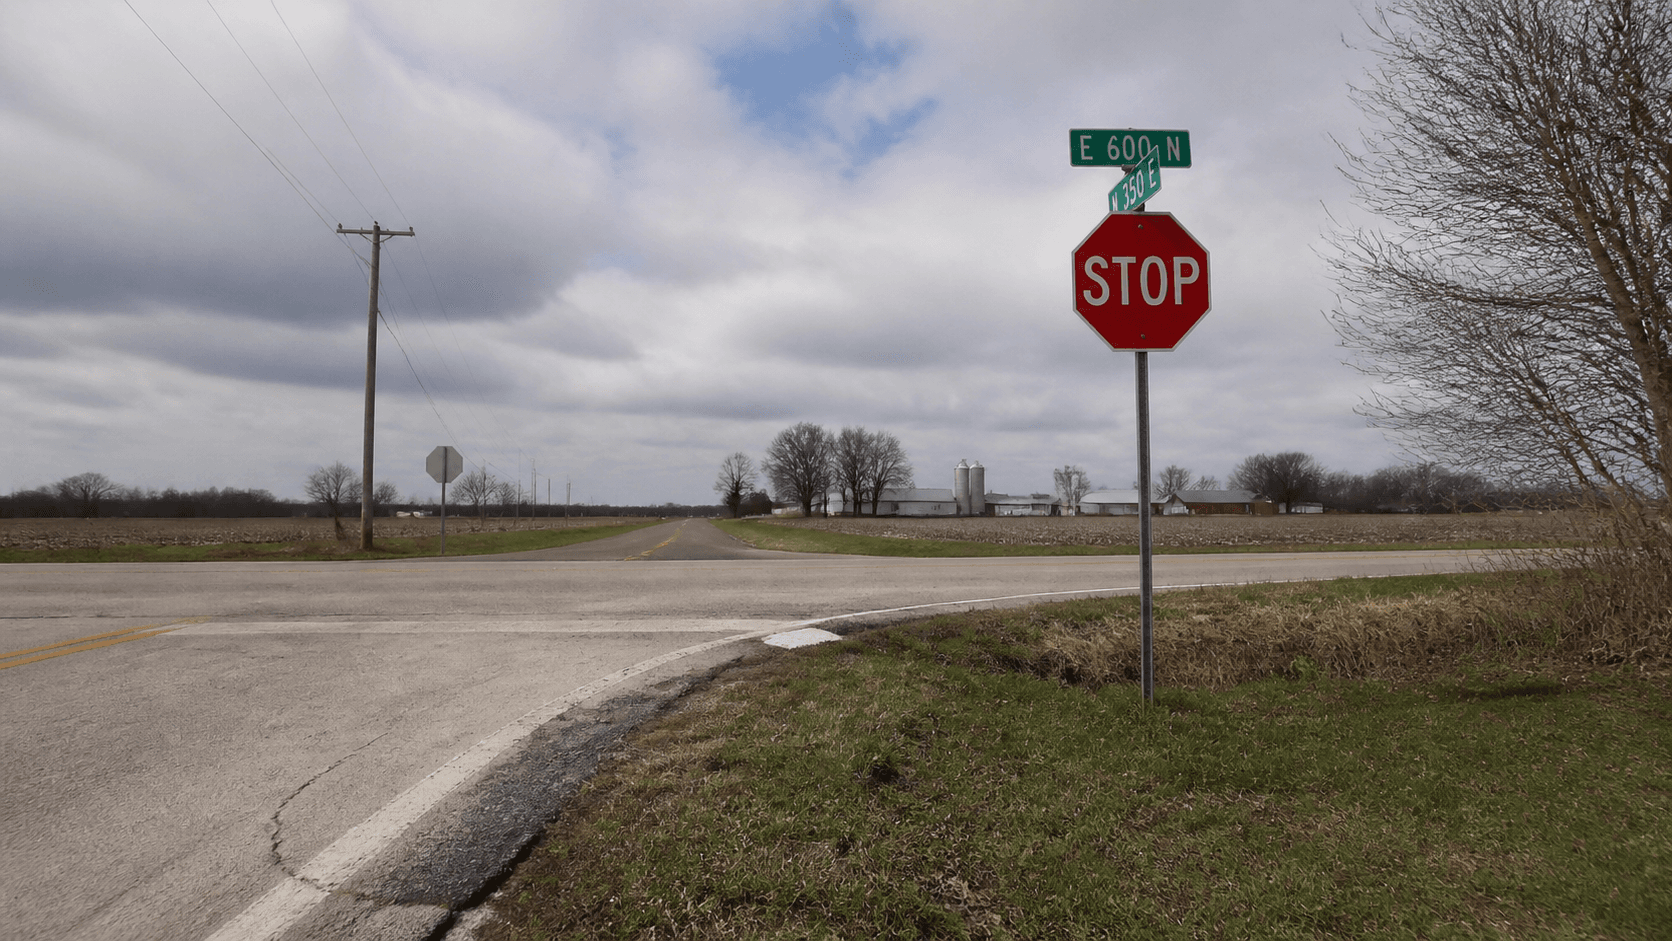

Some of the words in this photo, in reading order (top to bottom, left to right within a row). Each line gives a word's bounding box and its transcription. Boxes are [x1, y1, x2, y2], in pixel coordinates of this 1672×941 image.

[1080, 135, 1093, 160] E
[1107, 135, 1151, 160] 600
[1166, 136, 1180, 161] N
[1123, 170, 1144, 210] 350
[1148, 158, 1157, 188] E
[1083, 255, 1200, 307] STOP
